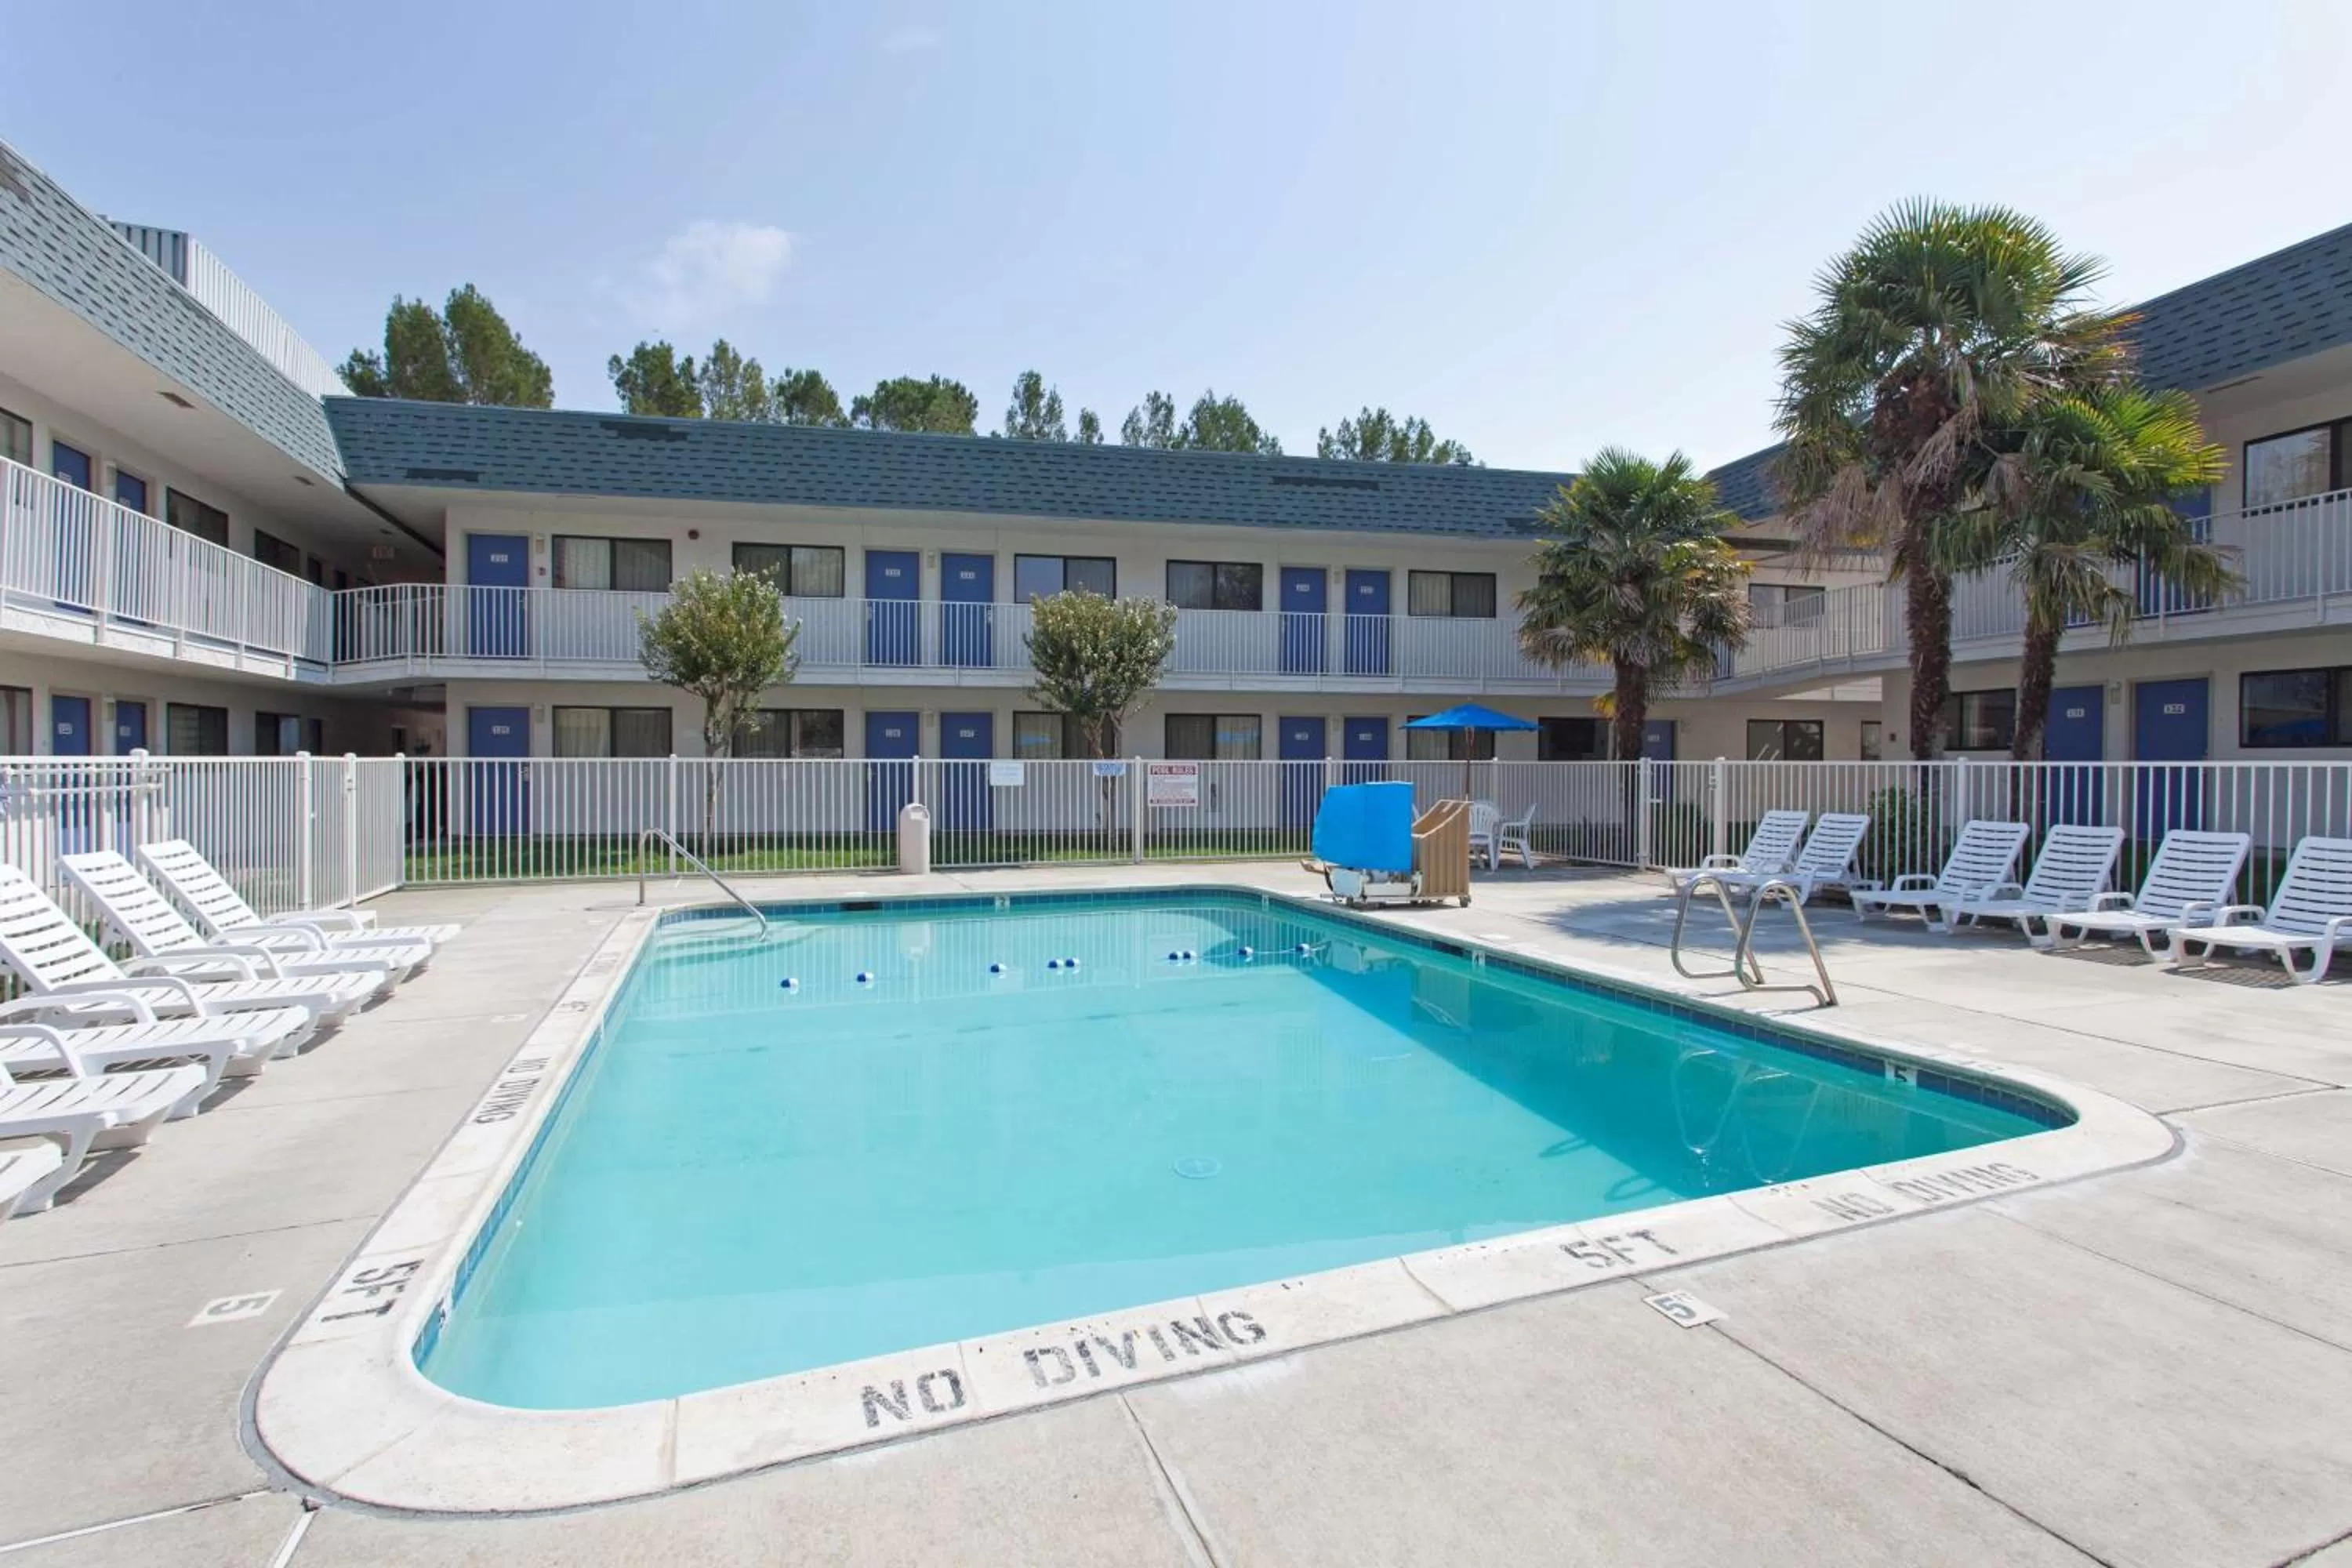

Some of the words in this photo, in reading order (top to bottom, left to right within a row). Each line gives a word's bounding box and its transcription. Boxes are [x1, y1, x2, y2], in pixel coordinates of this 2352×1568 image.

[473, 1078, 541, 1123] DIVING
[1809, 1192, 1895, 1221] NO
[1890, 1162, 2039, 1203] DIVING
[1559, 1229, 1679, 1269] 5FT
[206, 1294, 272, 1316] 5
[321, 1258, 425, 1323] 5FT
[1653, 1296, 1697, 1319] 5
[861, 1368, 965, 1428] NO
[1023, 1310, 1266, 1388] DIVING
